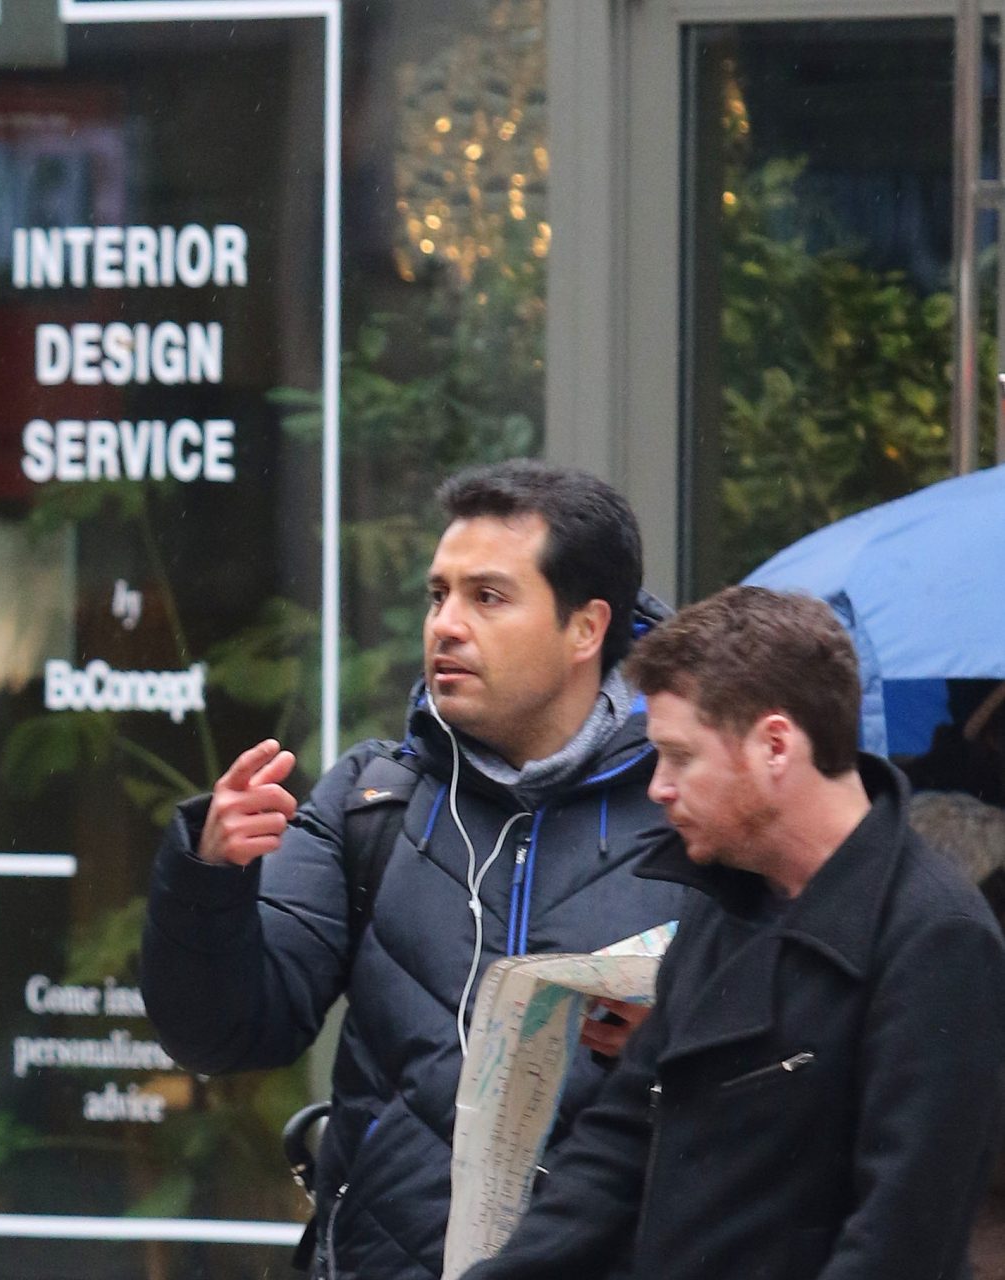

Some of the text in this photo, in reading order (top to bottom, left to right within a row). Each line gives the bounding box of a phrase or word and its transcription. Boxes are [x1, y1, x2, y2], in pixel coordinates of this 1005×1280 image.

[12, 224, 248, 289] INTERIOR
[35, 321, 223, 386] DESIGN
[21, 419, 236, 483] SERVICE
[112, 579, 142, 628] by
[44, 659, 207, 723] BoConcept
[25, 975, 101, 1015] Come
[83, 1083, 167, 1122] advice
